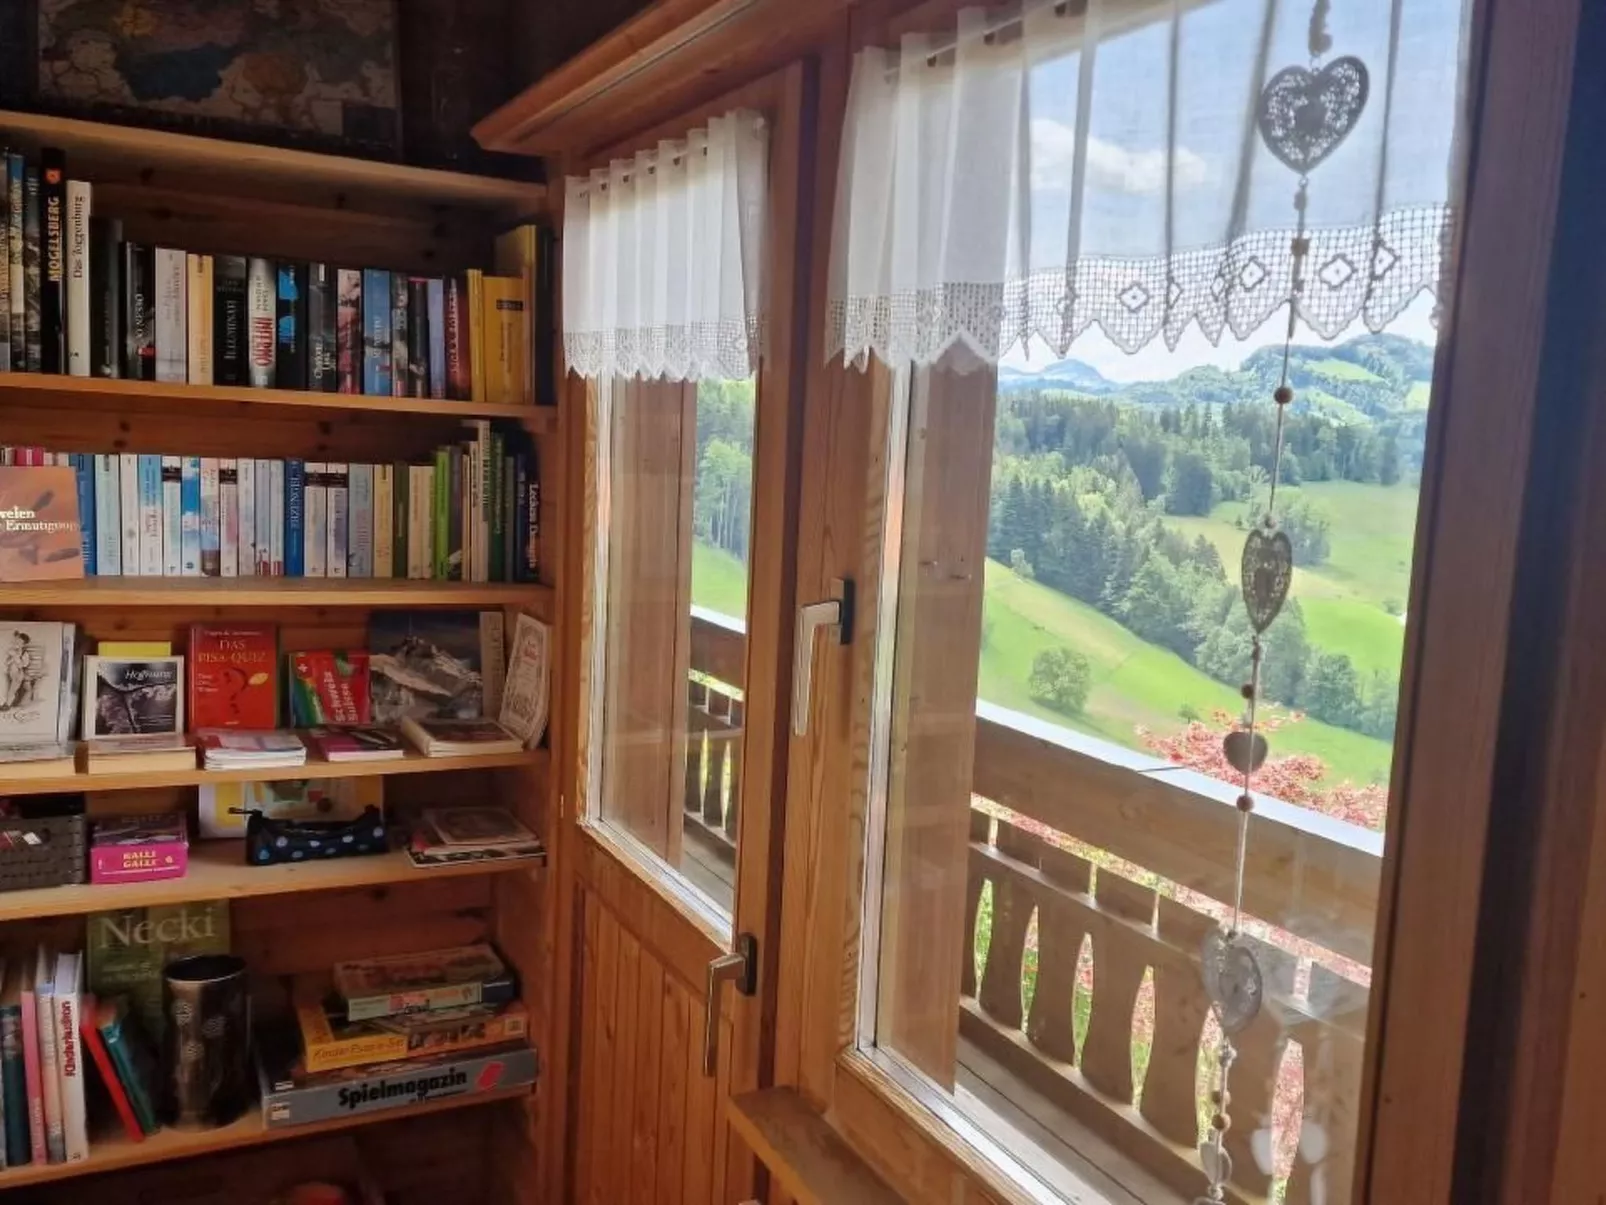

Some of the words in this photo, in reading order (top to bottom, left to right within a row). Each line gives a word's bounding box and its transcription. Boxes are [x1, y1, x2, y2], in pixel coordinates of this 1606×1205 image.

[48, 196, 61, 281] MOGELSBERG
[73, 195, 86, 257] Toggenburg
[73, 260, 84, 279] Das
[99, 907, 215, 948] Necki
[338, 1067, 467, 1109] Spielmagazin
